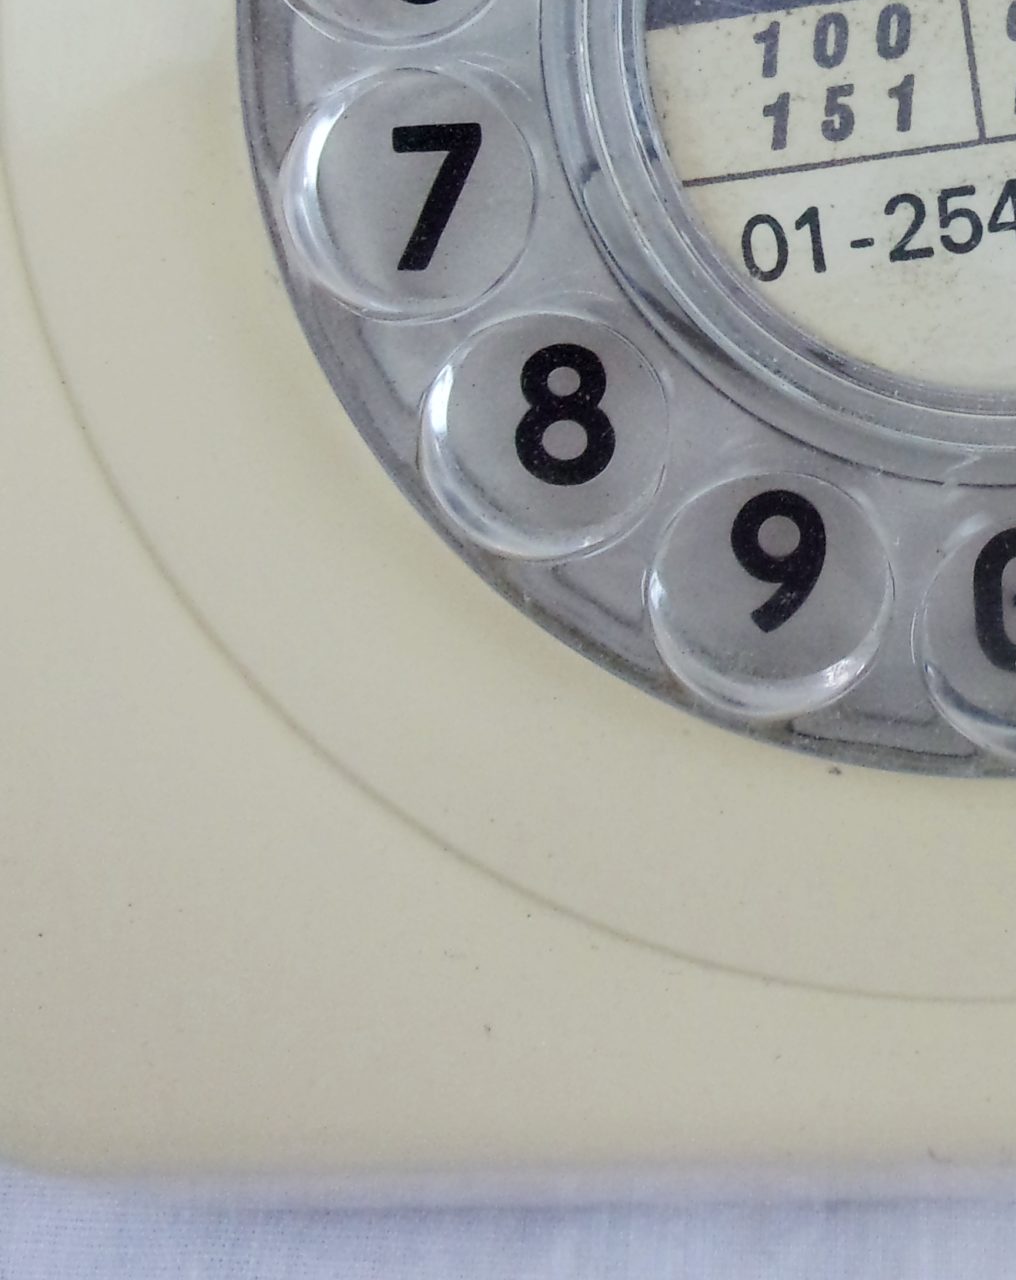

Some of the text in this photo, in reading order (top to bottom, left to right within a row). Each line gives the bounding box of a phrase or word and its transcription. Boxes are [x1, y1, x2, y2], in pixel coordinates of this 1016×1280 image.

[392, 123, 482, 271] 7
[515, 343, 616, 486] 8
[731, 489, 826, 633] 9
